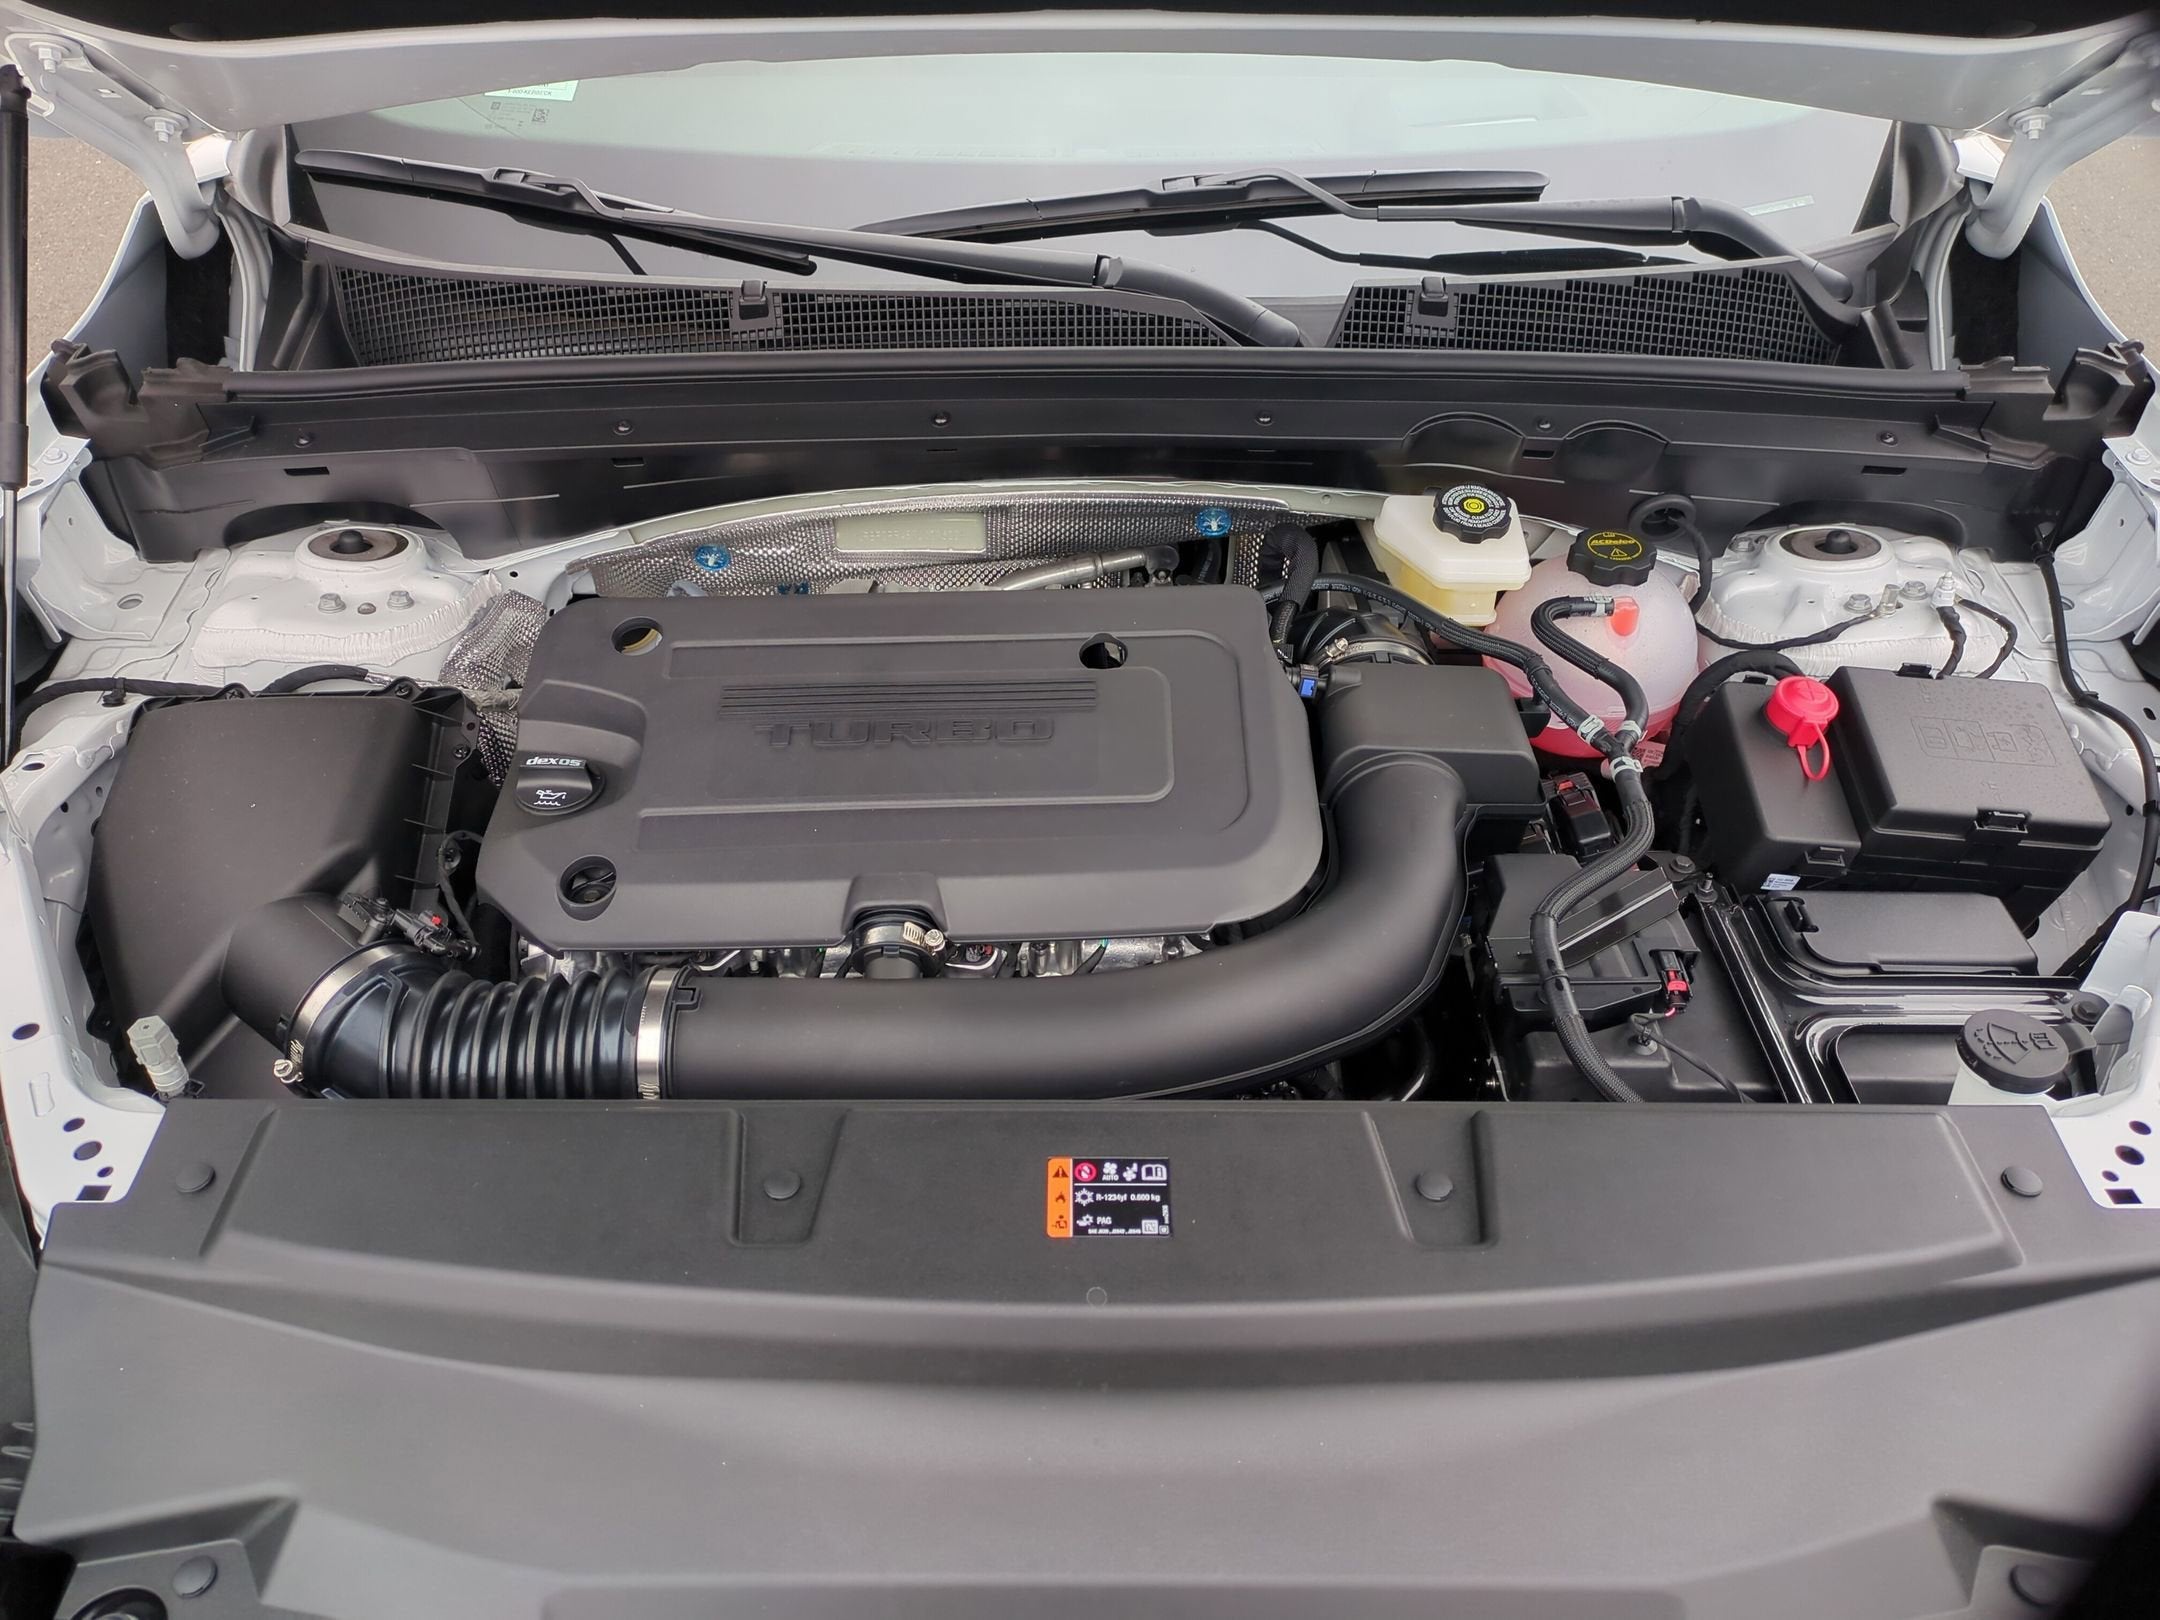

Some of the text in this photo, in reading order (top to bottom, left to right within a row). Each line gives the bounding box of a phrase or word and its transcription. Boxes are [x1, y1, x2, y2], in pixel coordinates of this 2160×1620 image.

[752, 717, 1055, 748] TURBO
[526, 756, 582, 767] dexos
[1096, 1216, 1112, 1225] PAG
